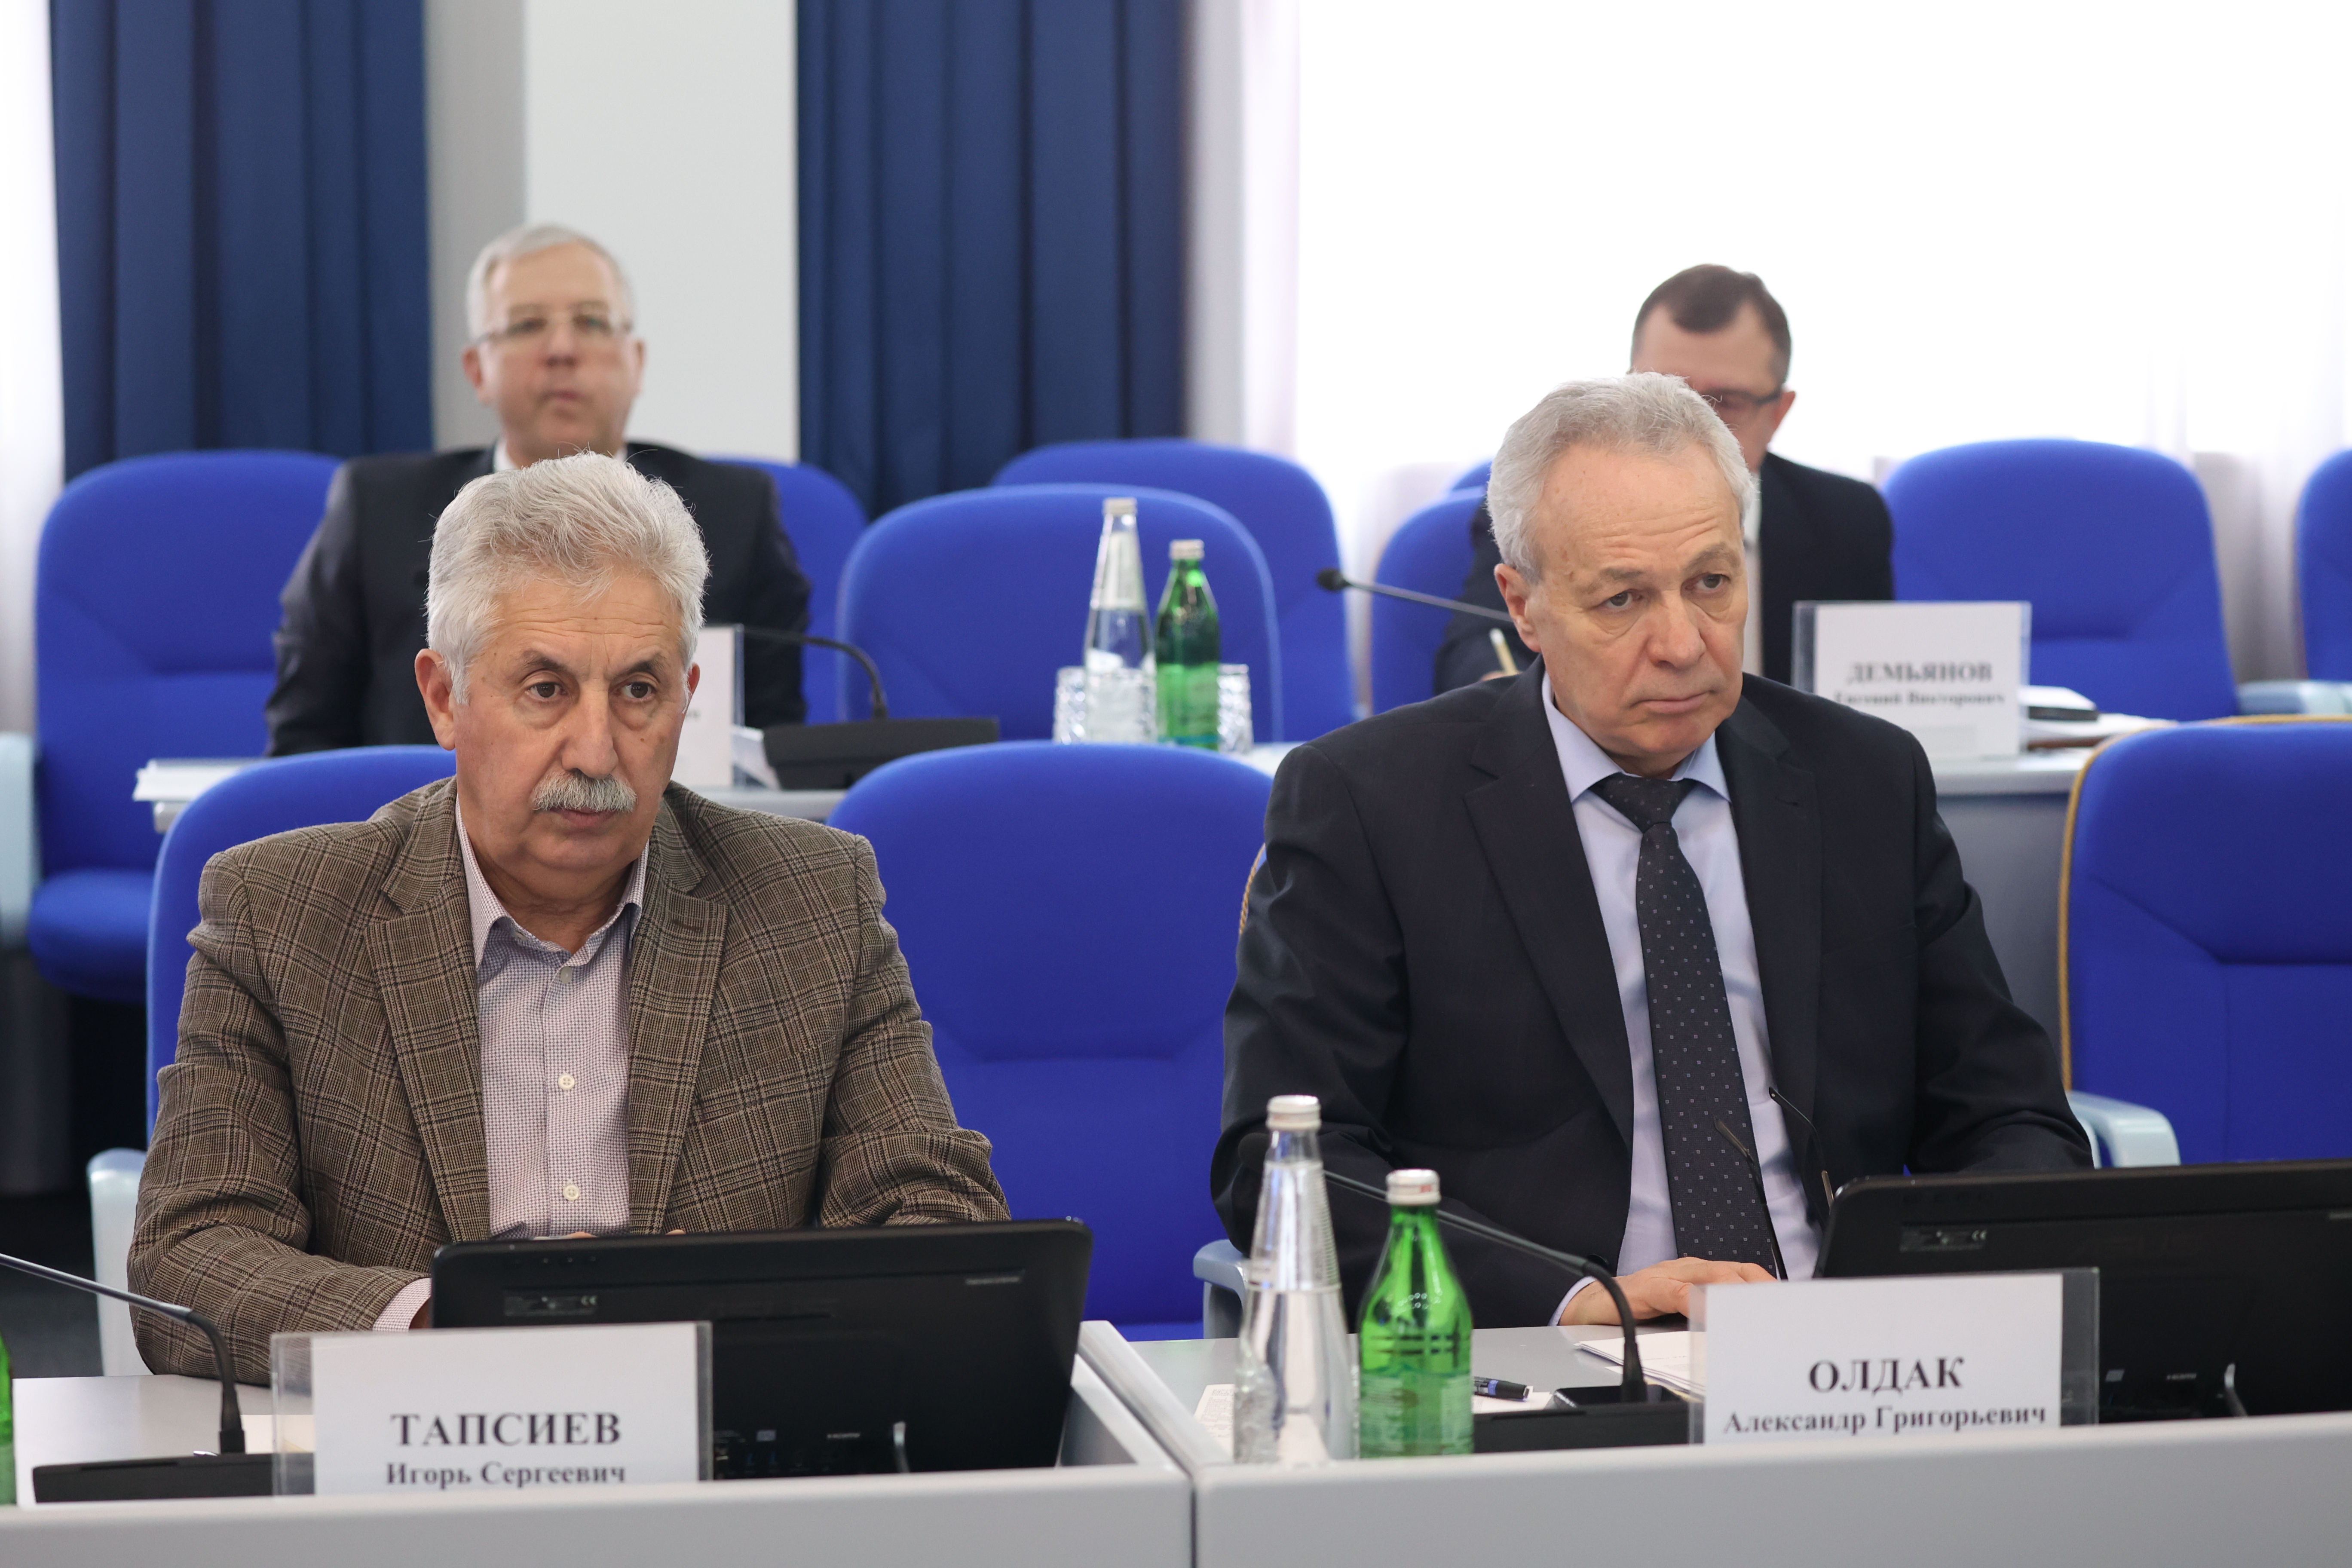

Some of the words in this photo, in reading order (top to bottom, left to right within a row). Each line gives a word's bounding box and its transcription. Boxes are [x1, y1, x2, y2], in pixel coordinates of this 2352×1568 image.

[1847, 662, 1993, 684] ДЕМЬЯНОВ
[1808, 1357, 1964, 1395] ОЛДАК
[390, 1412, 621, 1446] ТАПСИЕВ
[1724, 1411, 1866, 1436] Александр
[1875, 1405, 2046, 1434] Григорьевич
[386, 1462, 472, 1490] Игорь
[480, 1461, 625, 1488] Сергеевич
